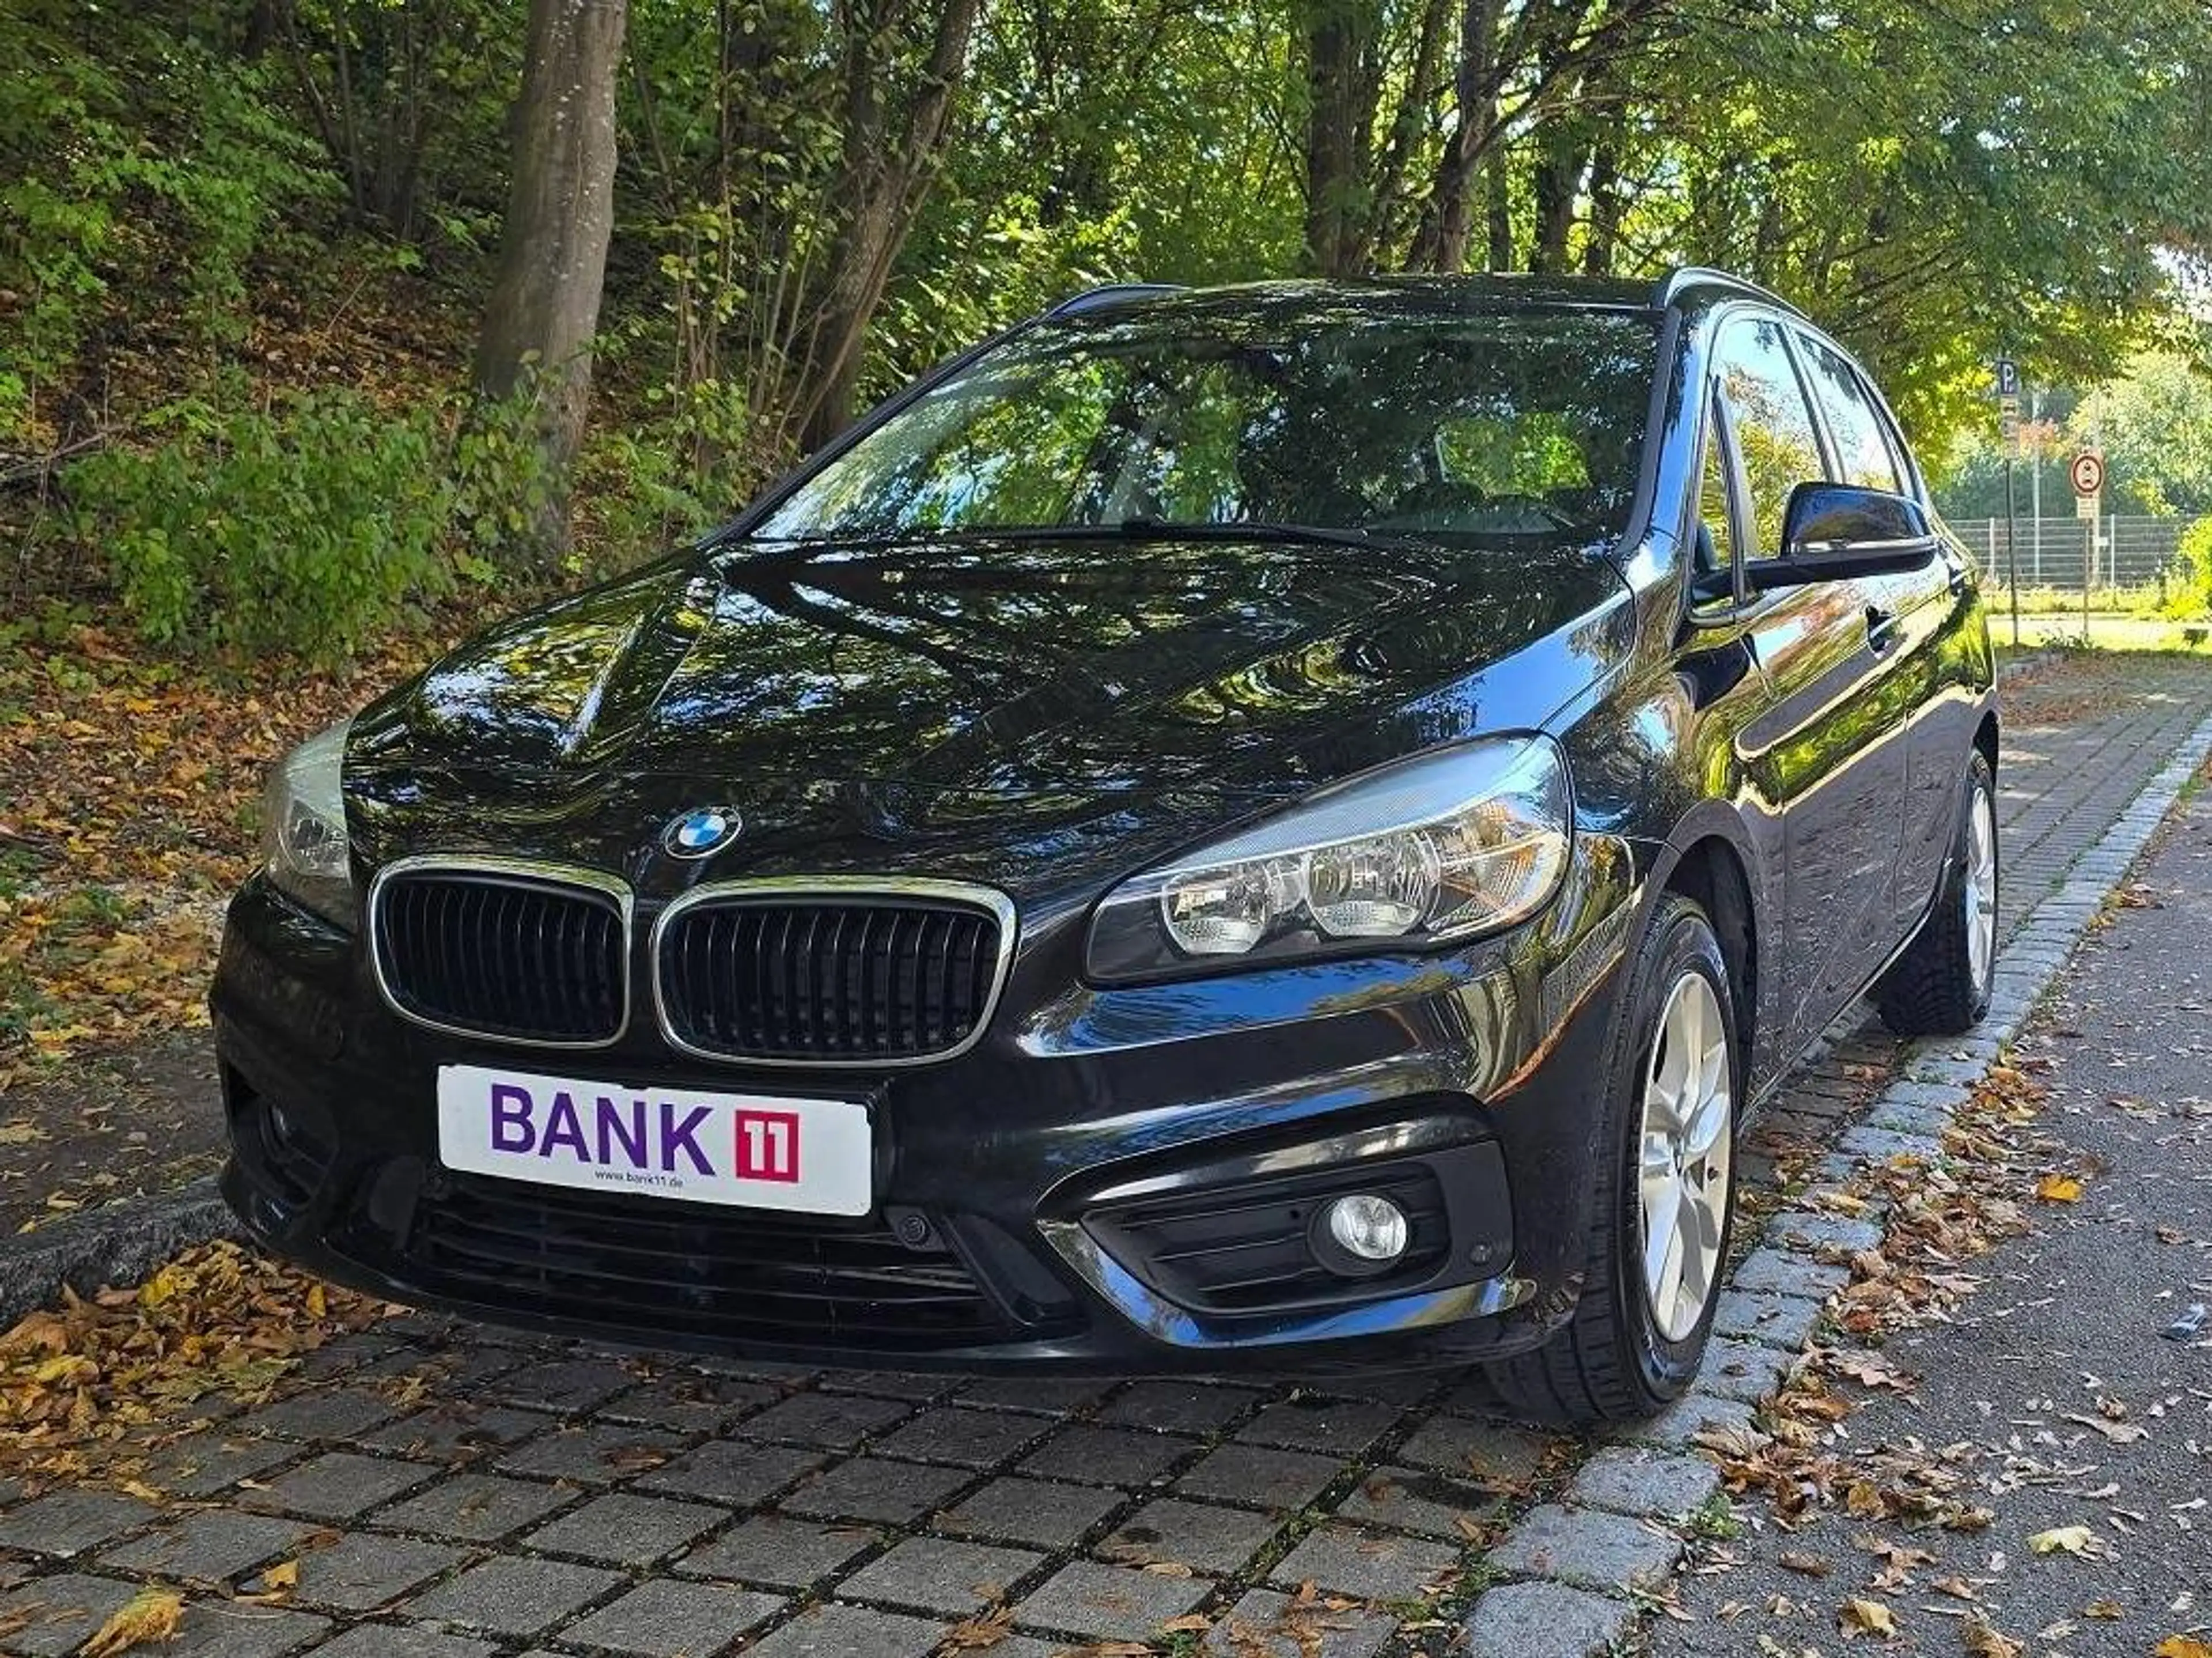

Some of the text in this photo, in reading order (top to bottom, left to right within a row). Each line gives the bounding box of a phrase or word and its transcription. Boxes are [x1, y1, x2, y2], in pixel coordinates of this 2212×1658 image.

[2003, 363, 2014, 392] P
[491, 1083, 789, 1177] BANK 11
[594, 1170, 683, 1188] www.bank11.de
